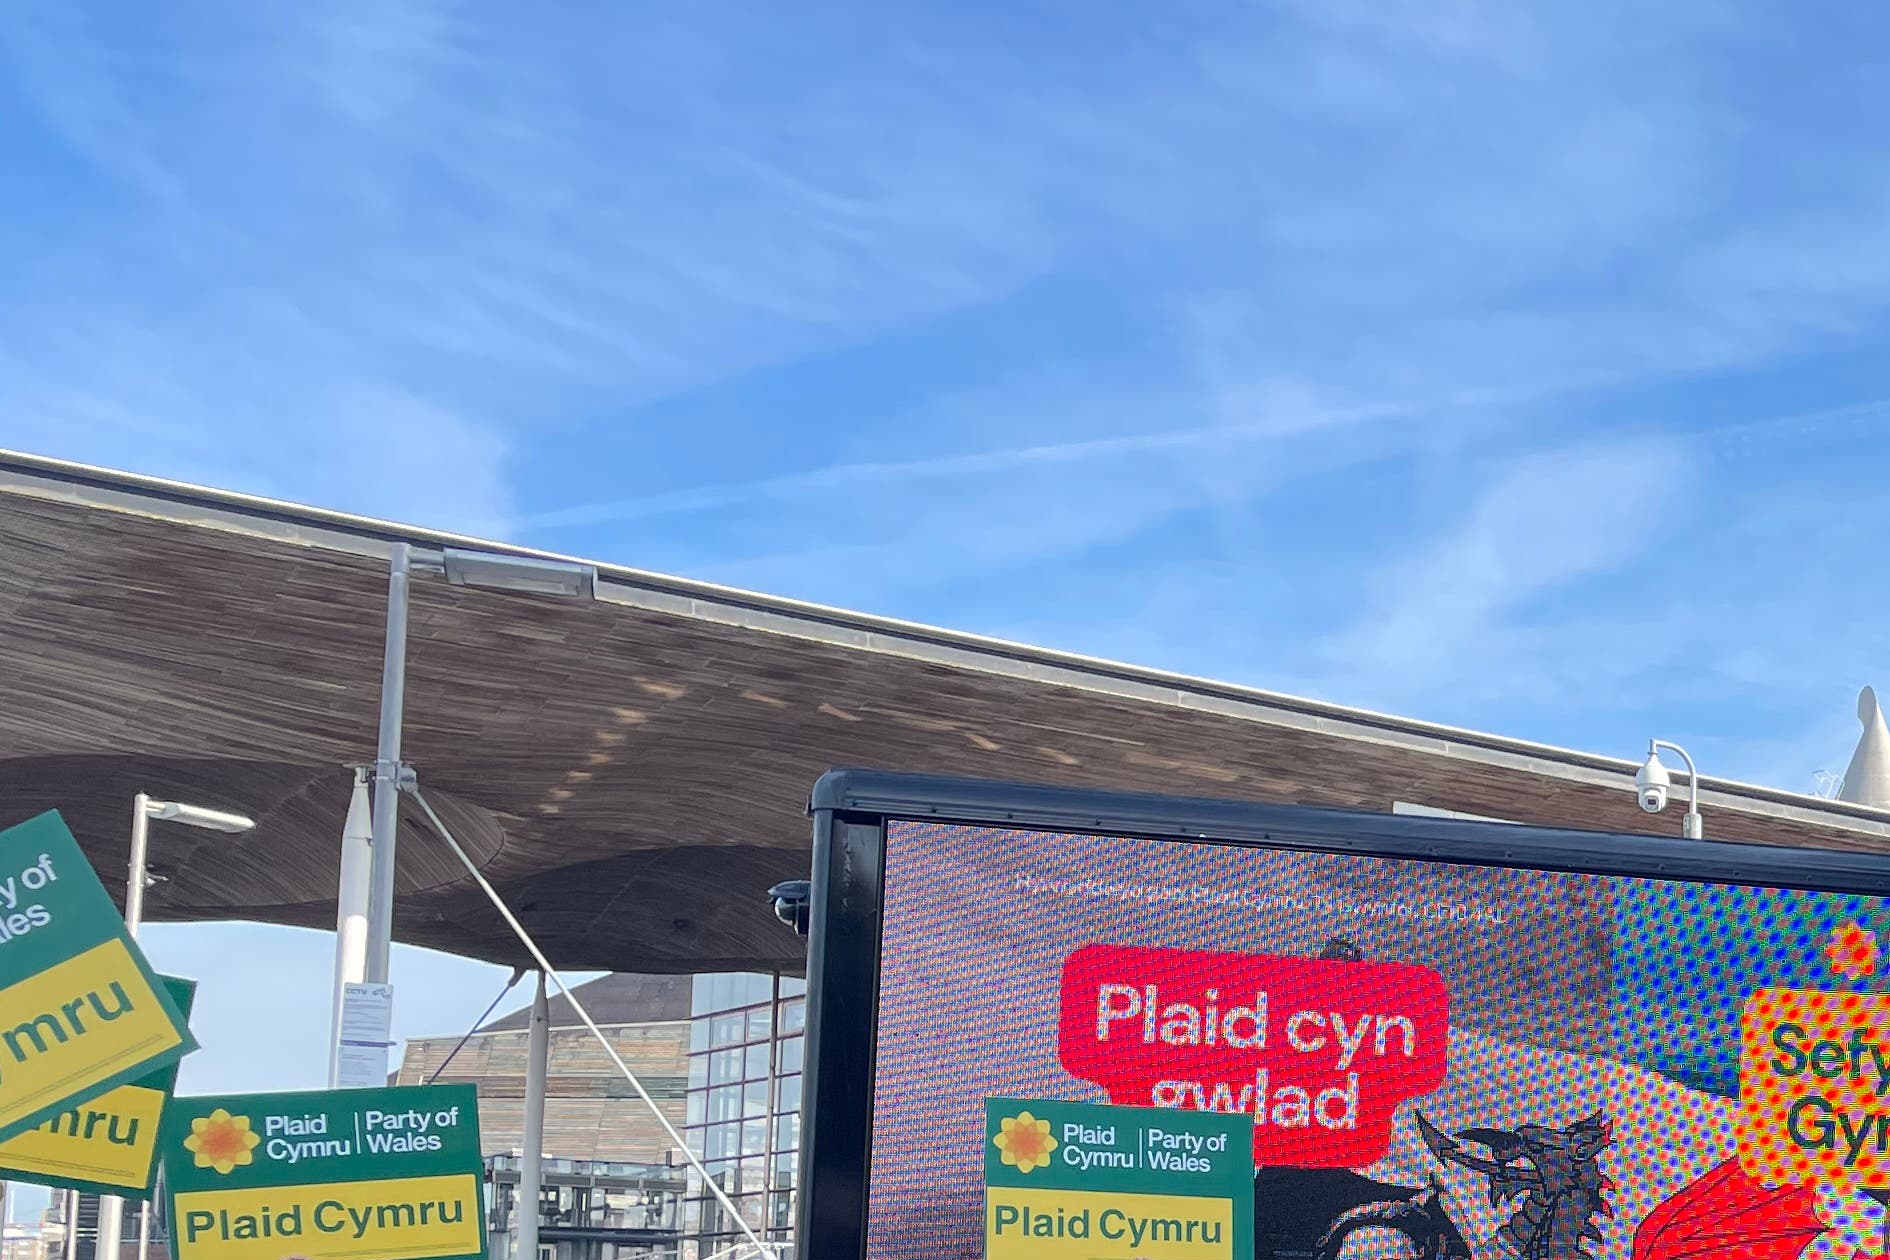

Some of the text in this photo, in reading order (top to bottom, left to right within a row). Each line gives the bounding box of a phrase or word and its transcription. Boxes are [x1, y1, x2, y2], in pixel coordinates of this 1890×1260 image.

[22, 853, 58, 890] of
[0, 903, 51, 944] les
[1, 980, 135, 1063] mru
[1096, 983, 1415, 1071] Plaid cyn
[265, 1114, 327, 1136] Plaid
[365, 1107, 459, 1132] Party of
[366, 1131, 442, 1153] Wales
[1063, 1123, 1115, 1146] Plaid
[1148, 1129, 1227, 1154] Party of
[266, 1137, 350, 1164] Cymru
[1062, 1145, 1134, 1171] Cymru
[1148, 1150, 1211, 1173] Wales
[186, 1200, 463, 1243] Plaid Cymru
[995, 1205, 1221, 1248] Plaid Cymru
